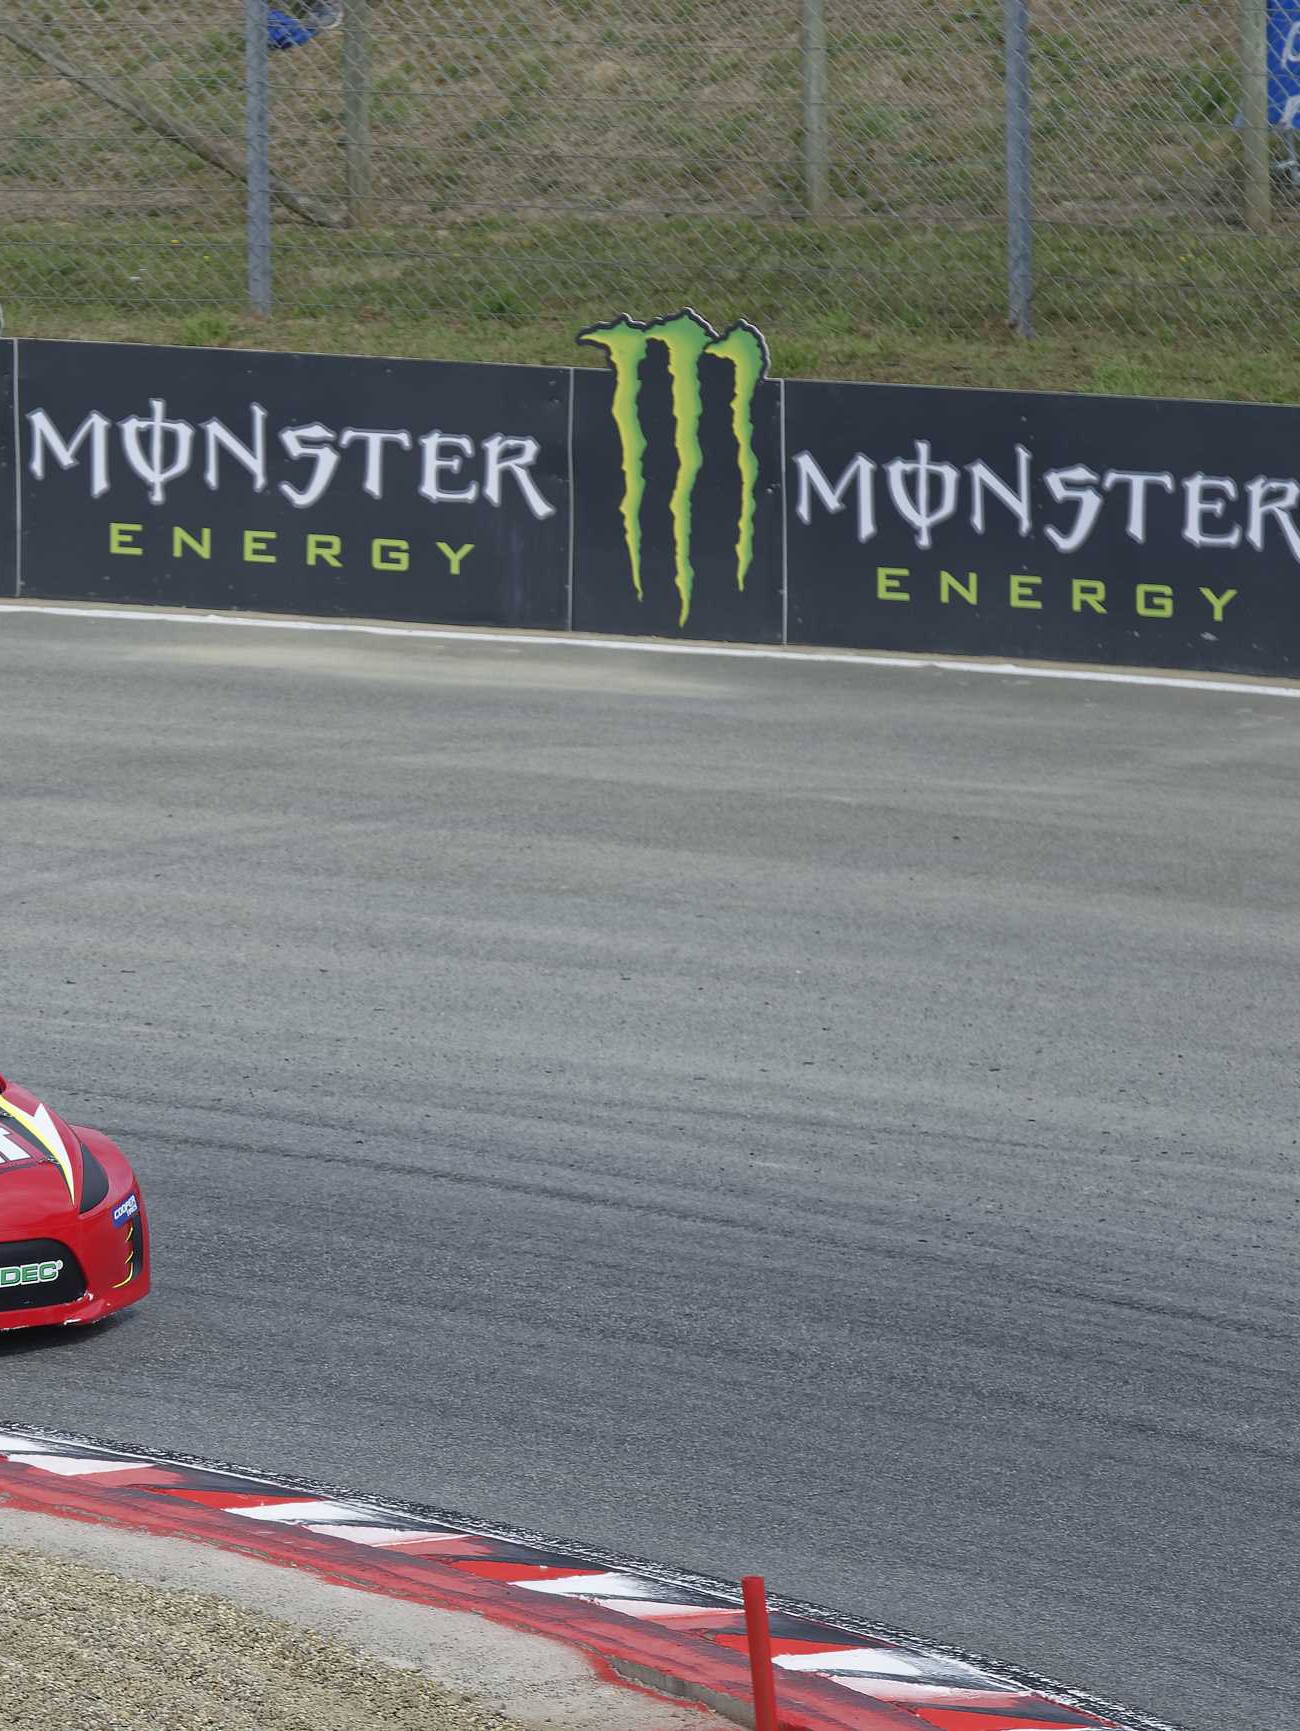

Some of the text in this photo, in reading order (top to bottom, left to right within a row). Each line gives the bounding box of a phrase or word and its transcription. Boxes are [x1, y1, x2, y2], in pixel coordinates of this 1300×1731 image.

[26, 398, 556, 519] MONSTER
[791, 439, 1300, 564] MONSTER
[109, 522, 475, 575] ENERGY
[876, 566, 1238, 622] ENERGY
